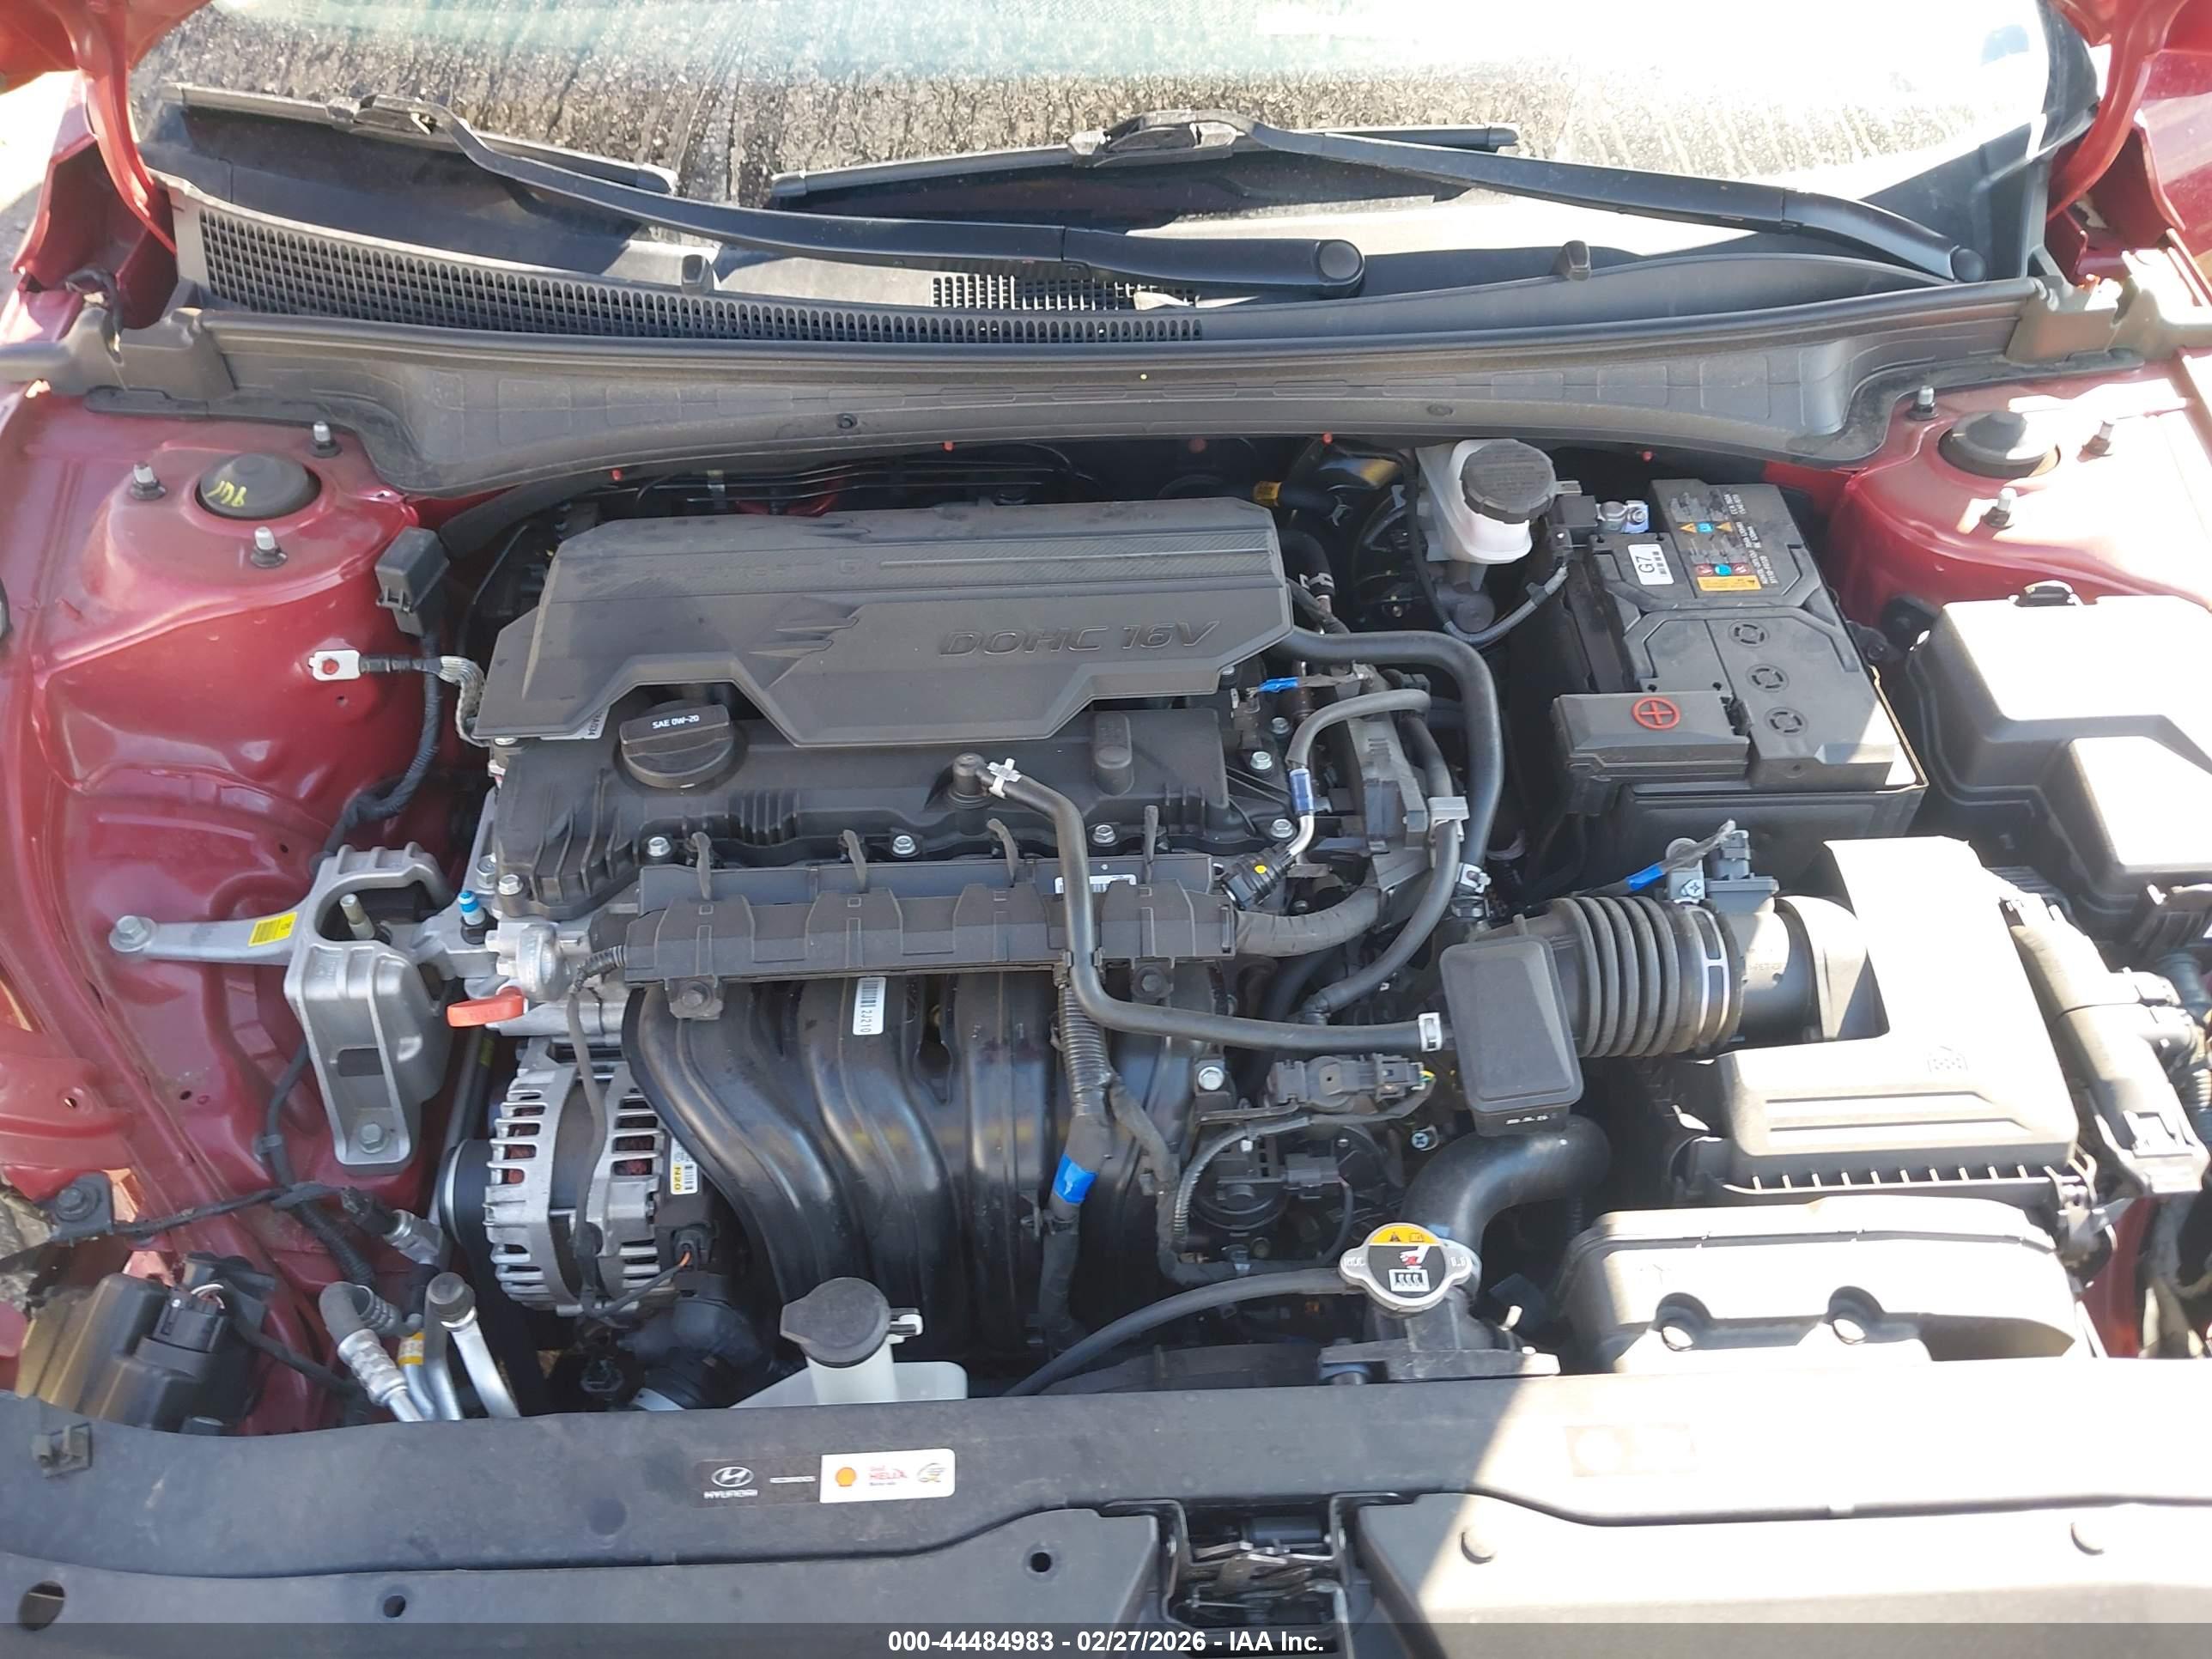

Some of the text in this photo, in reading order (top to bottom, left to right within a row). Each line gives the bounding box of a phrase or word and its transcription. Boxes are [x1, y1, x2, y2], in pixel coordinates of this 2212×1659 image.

[1636, 556, 1656, 574] G7
[939, 619, 1220, 657] DOHC 16V
[652, 714, 701, 729] SAE 0W-20
[860, 1009, 873, 1033] 2J210
[703, 1488, 759, 1499] HYUNDAI
